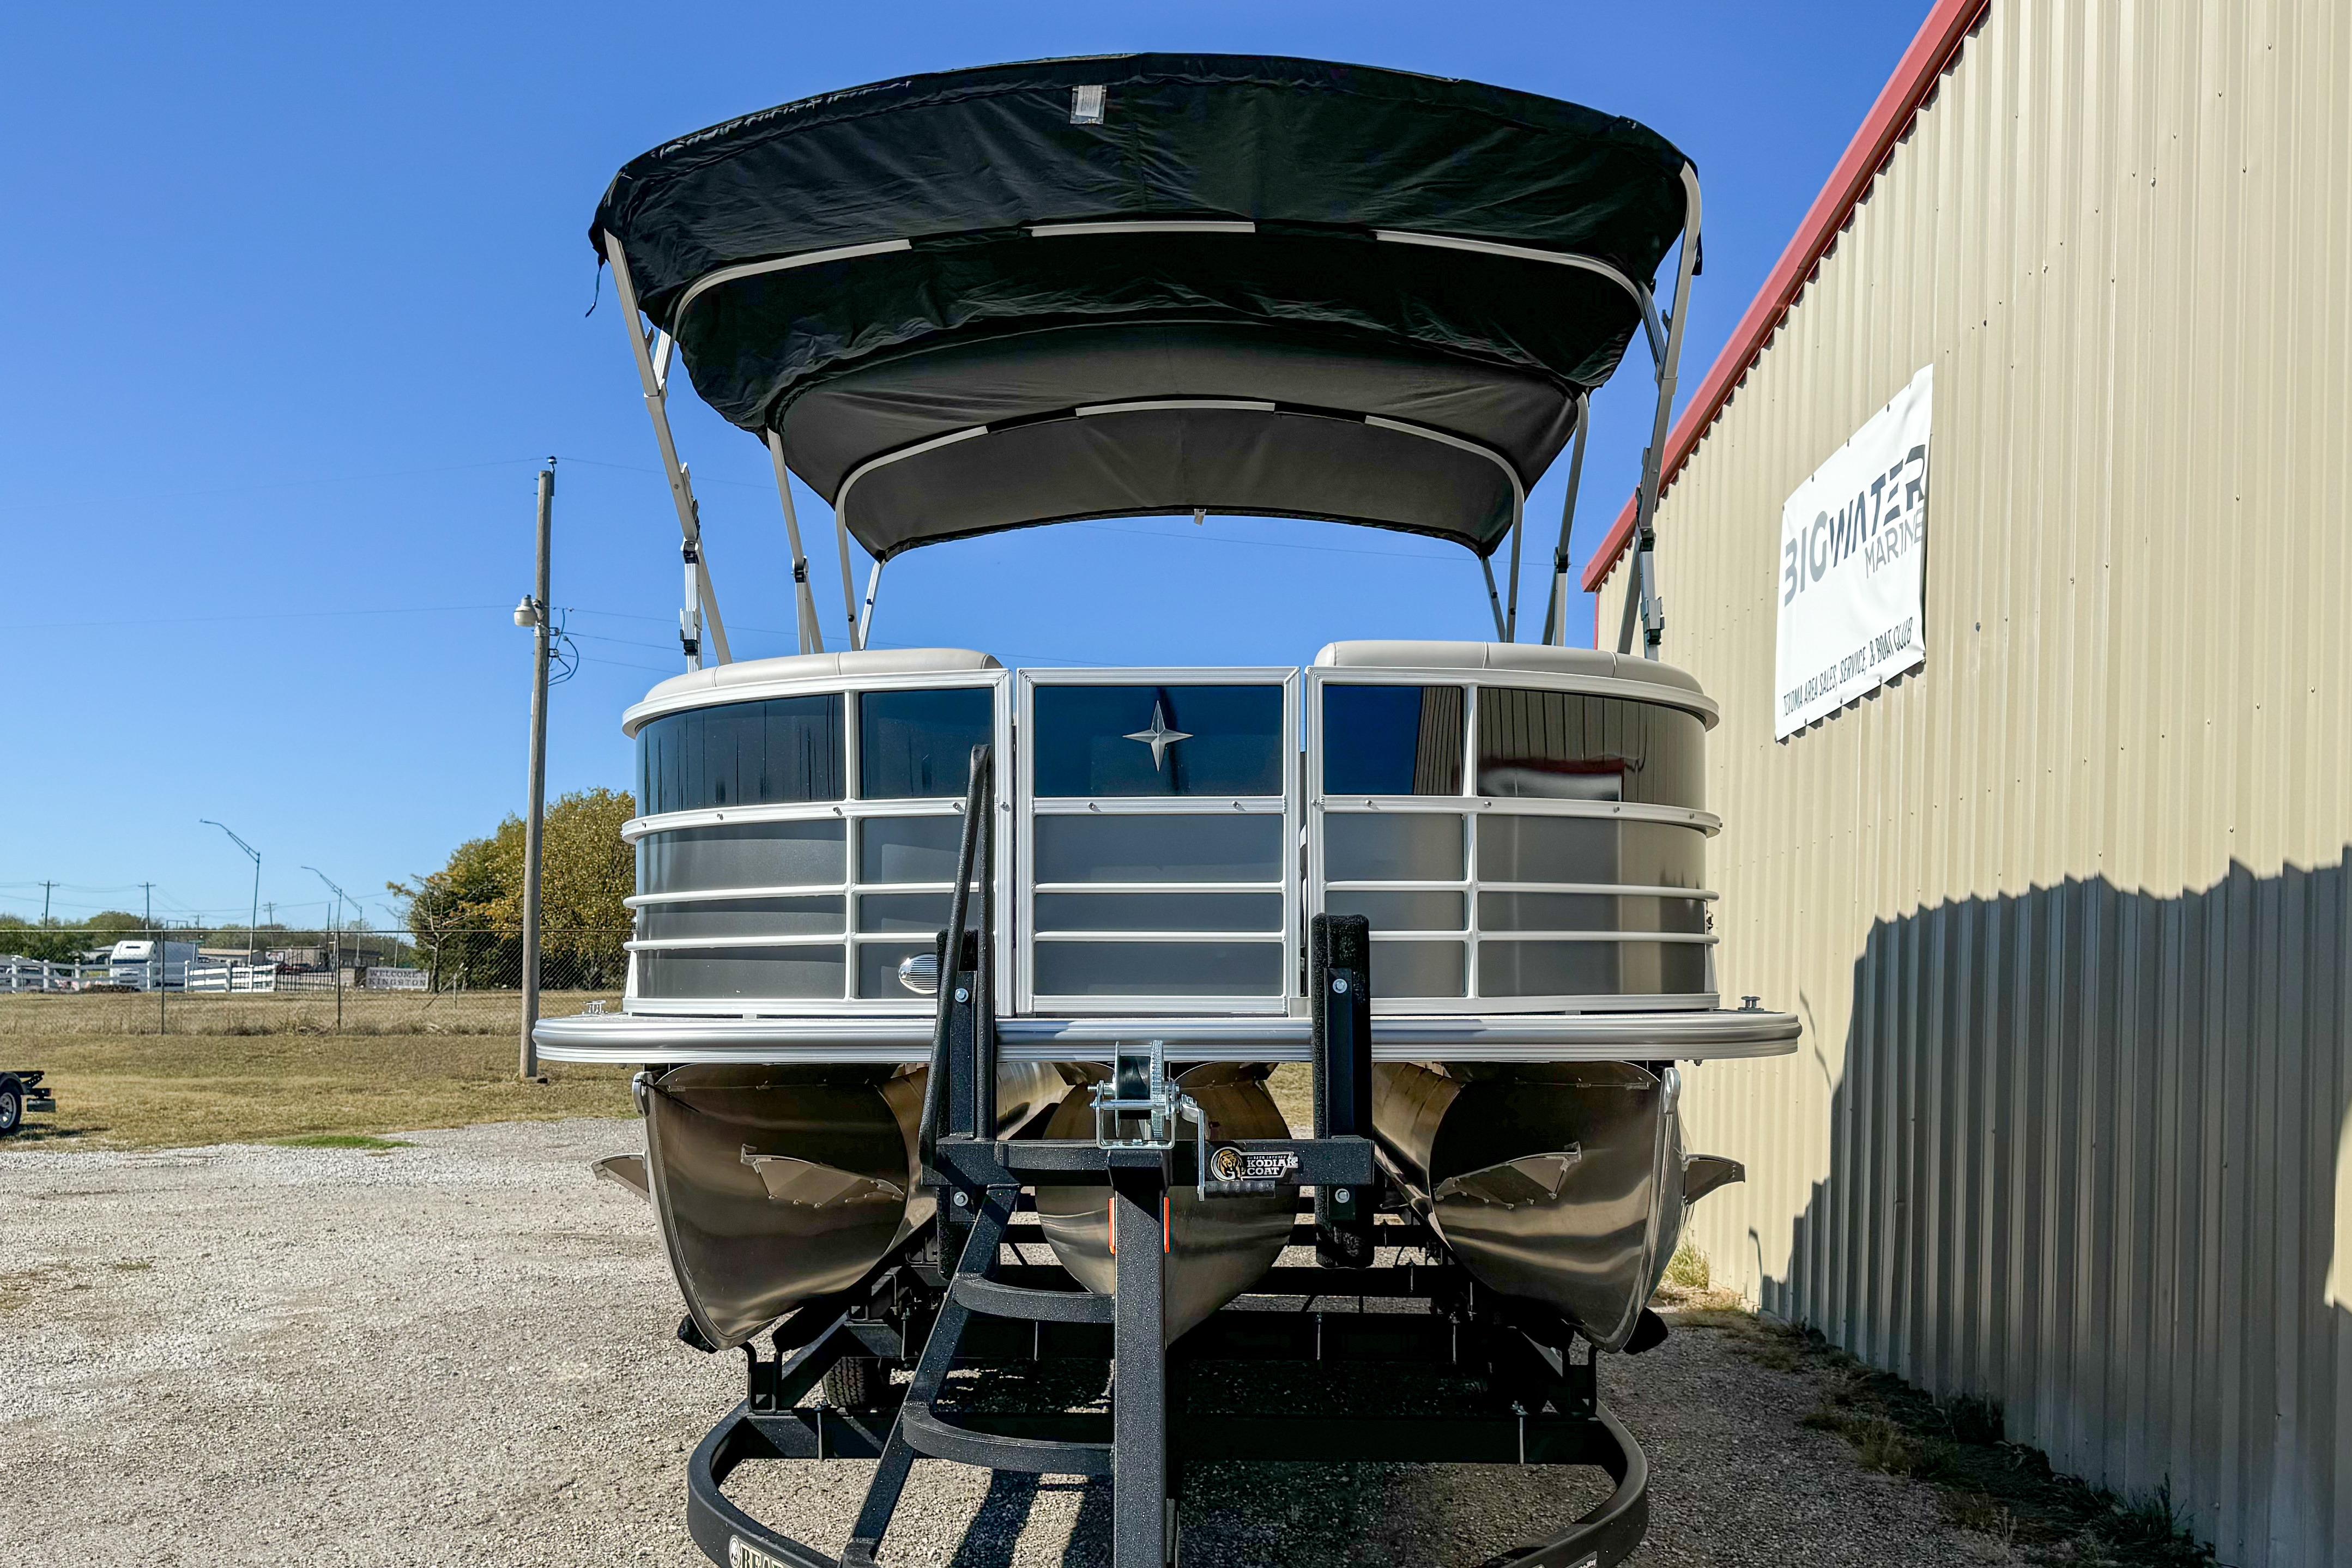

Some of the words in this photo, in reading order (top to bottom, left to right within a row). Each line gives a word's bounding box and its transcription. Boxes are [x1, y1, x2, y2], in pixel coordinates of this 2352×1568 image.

[1785, 444, 1925, 607] BIGWATER
[1865, 507, 1924, 579] MARINE
[1804, 676, 1817, 705] AREA
[1819, 664, 1837, 696] SALES,
[1840, 646, 1867, 684] SERVICE,
[1870, 640, 1875, 667] &
[1875, 629, 1894, 663] BOAT
[1893, 616, 1913, 651] CLUB
[1247, 1157, 1298, 1168] KODIAK
[1247, 1167, 1279, 1175] COAT
